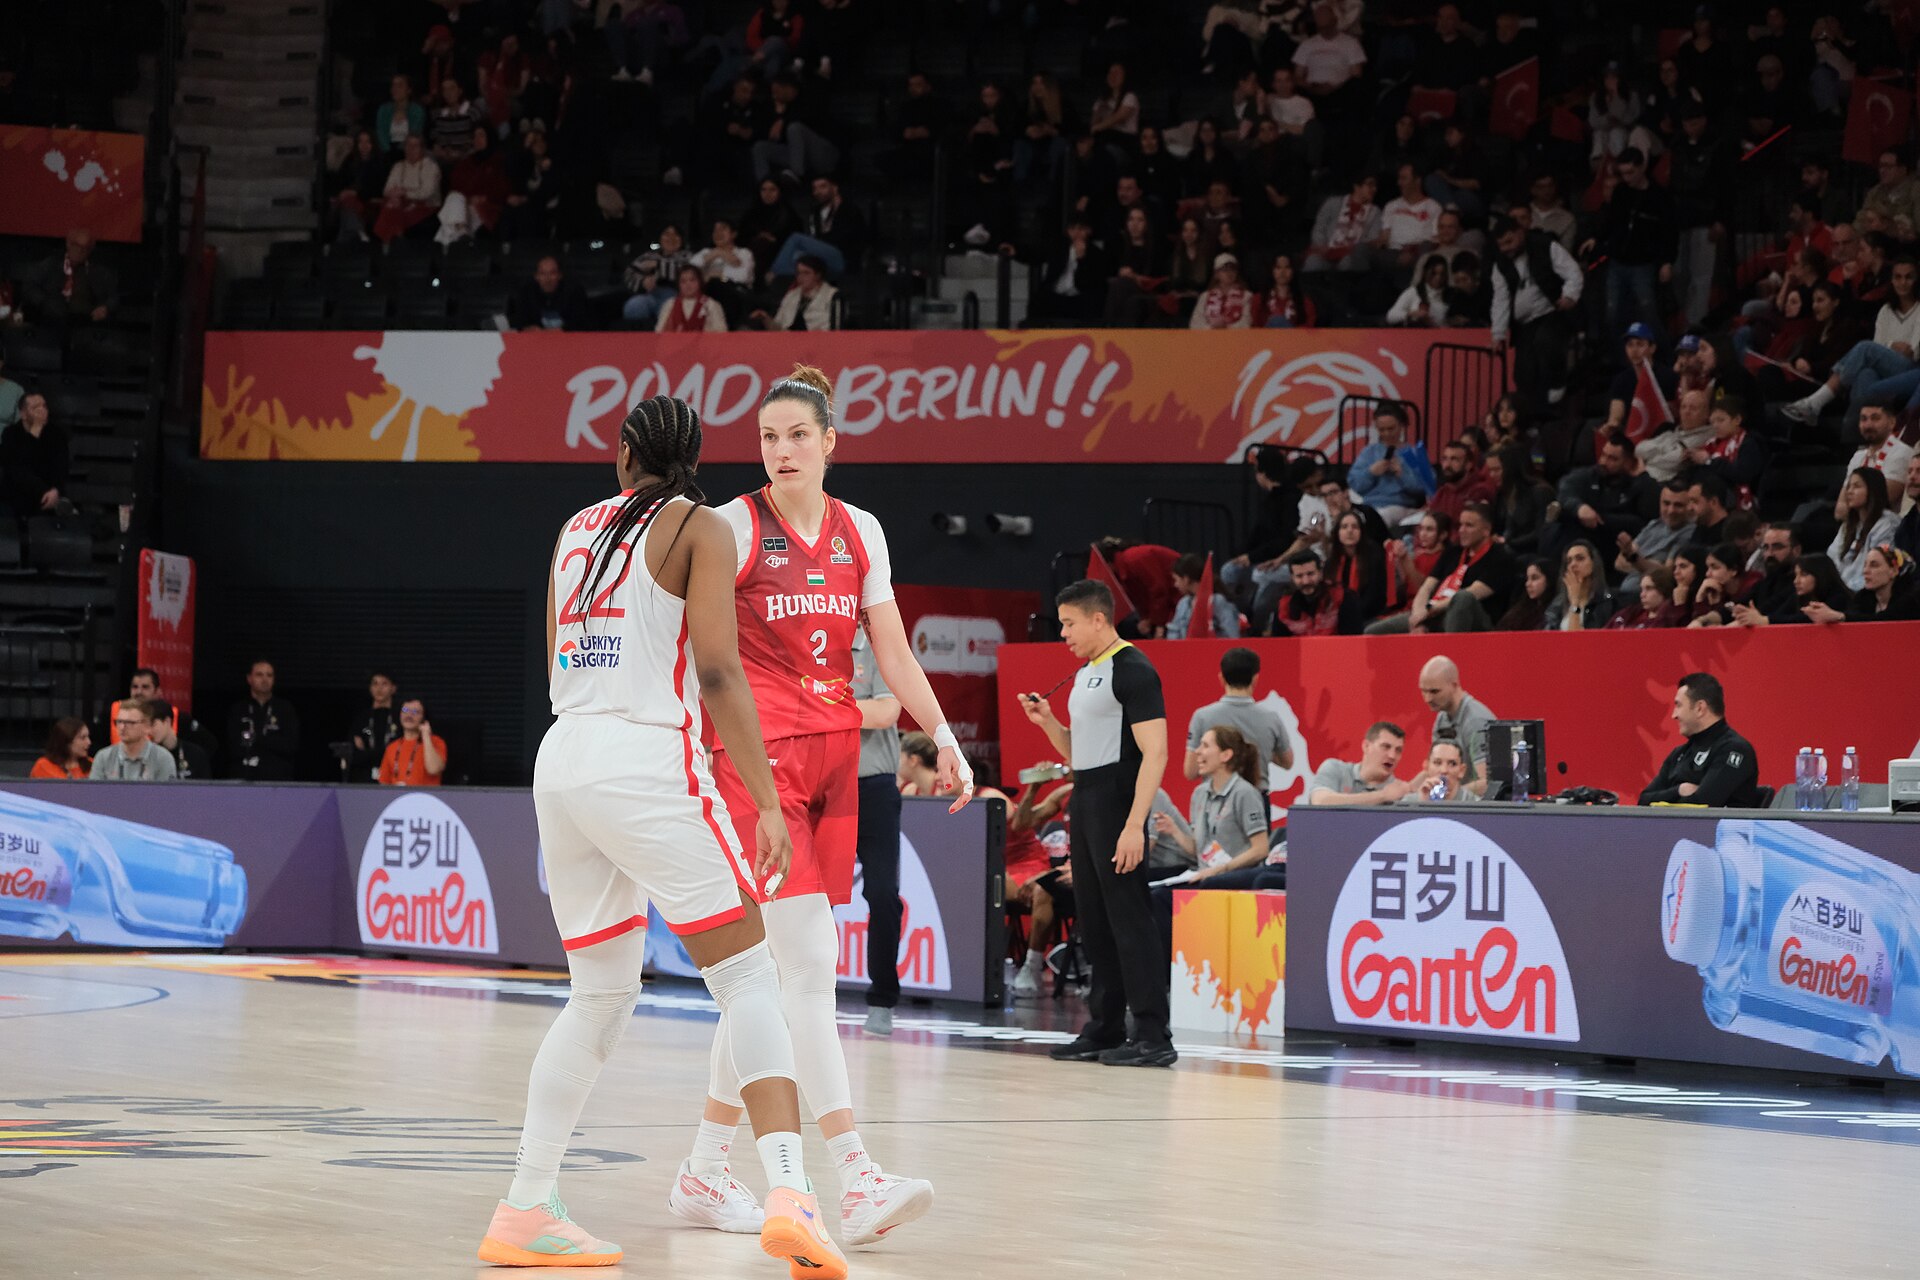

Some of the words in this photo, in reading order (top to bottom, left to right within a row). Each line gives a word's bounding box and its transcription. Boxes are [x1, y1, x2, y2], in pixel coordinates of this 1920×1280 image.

[831, 343, 1119, 436] BERLIN!!
[559, 541, 633, 625] 22
[766, 594, 858, 622] HUNGARY
[809, 629, 828, 666] 2
[384, 818, 459, 869] 百岁山
[366, 868, 486, 948] Ganten
[1370, 851, 1506, 922] 百岁山
[1816, 896, 1862, 935] 百岁山
[1341, 920, 1556, 1034] Ganten
[1779, 936, 1869, 1006] Ganten
